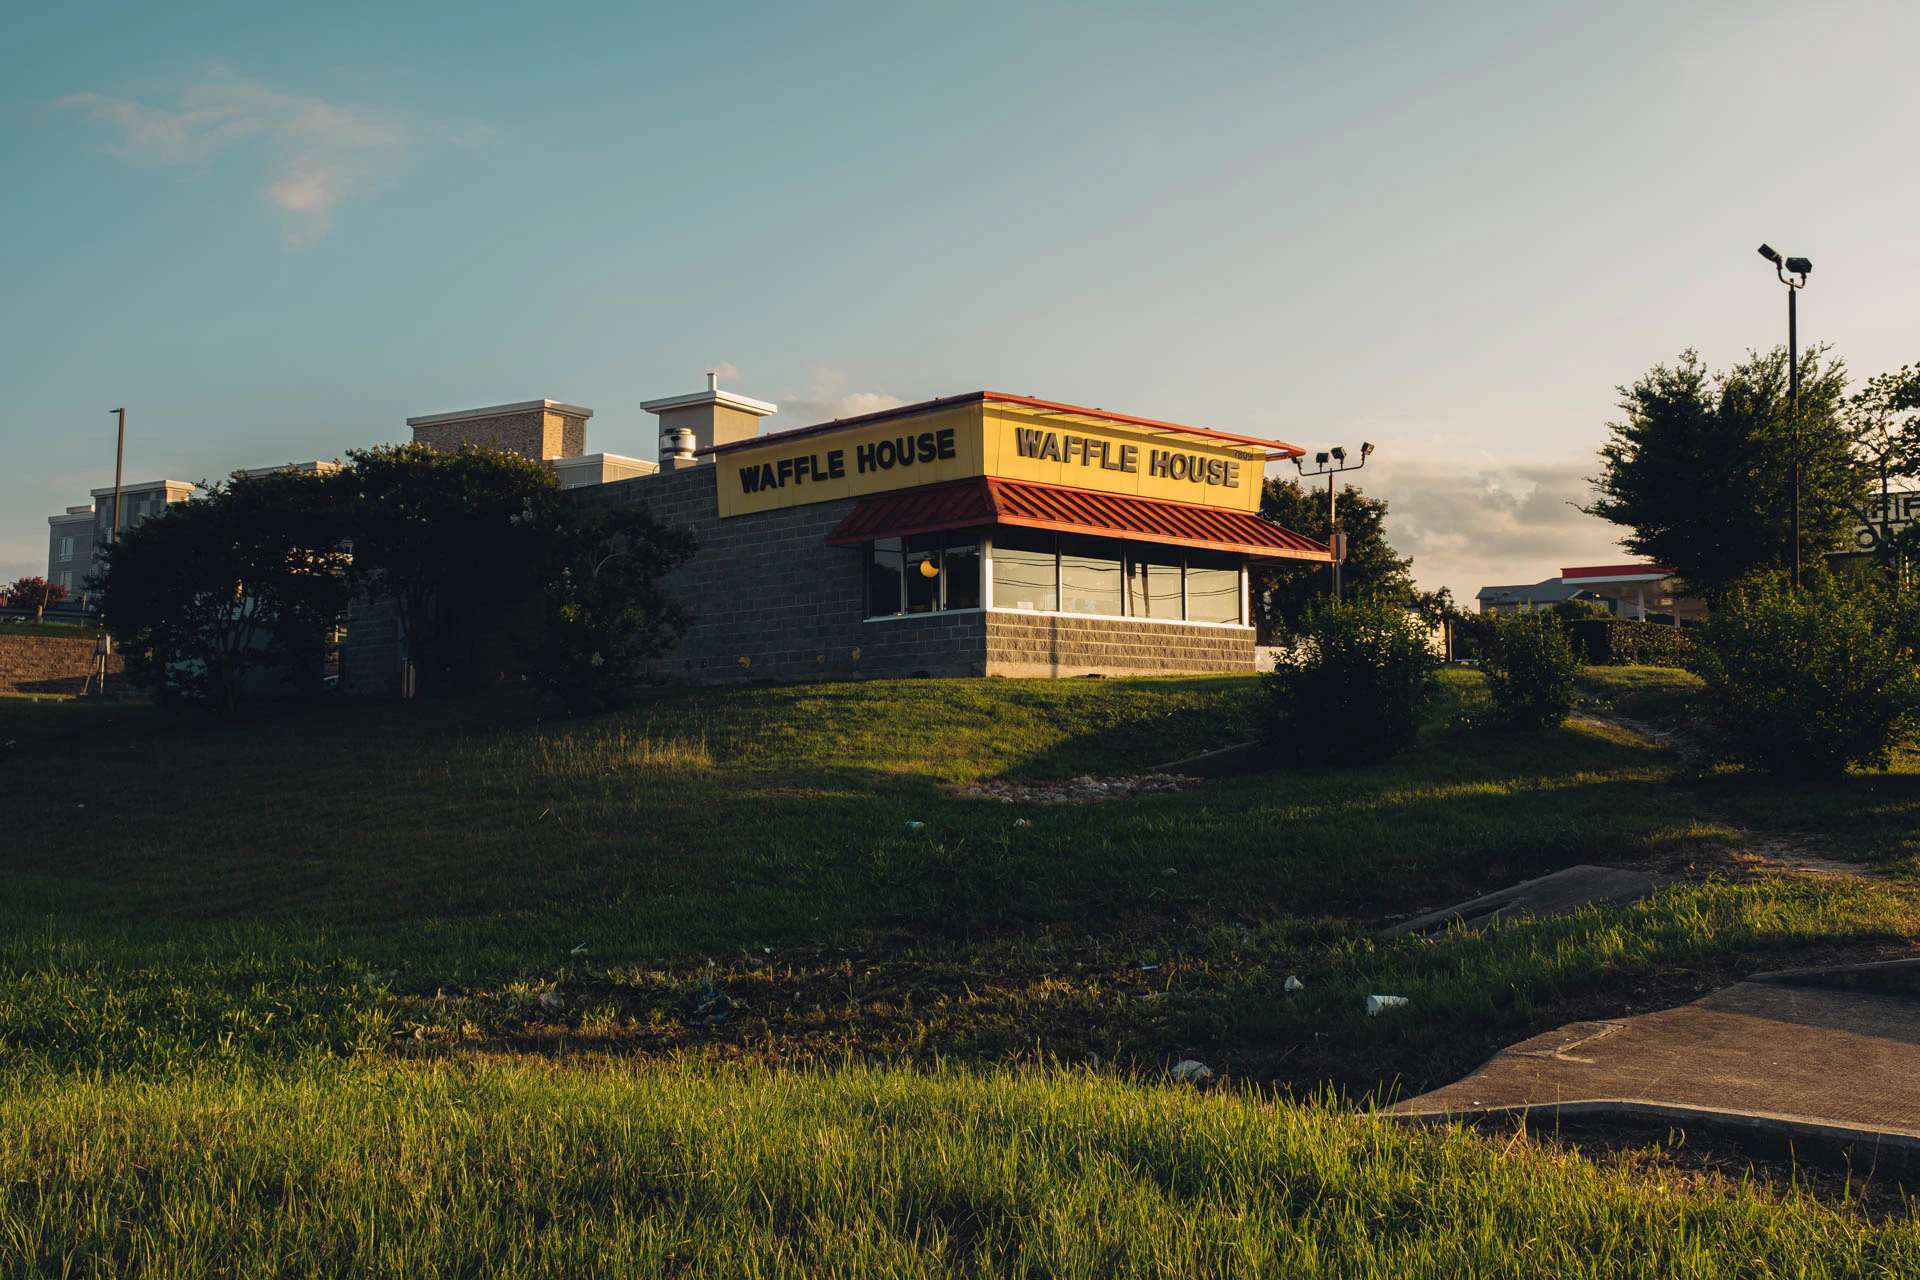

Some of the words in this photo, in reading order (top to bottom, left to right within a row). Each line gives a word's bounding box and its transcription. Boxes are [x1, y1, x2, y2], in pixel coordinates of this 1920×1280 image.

[739, 449, 845, 493] WAFFLE
[857, 428, 956, 473] HOUSE
[1015, 427, 1138, 473] WAFFLE
[1150, 449, 1240, 488] HOUSE
